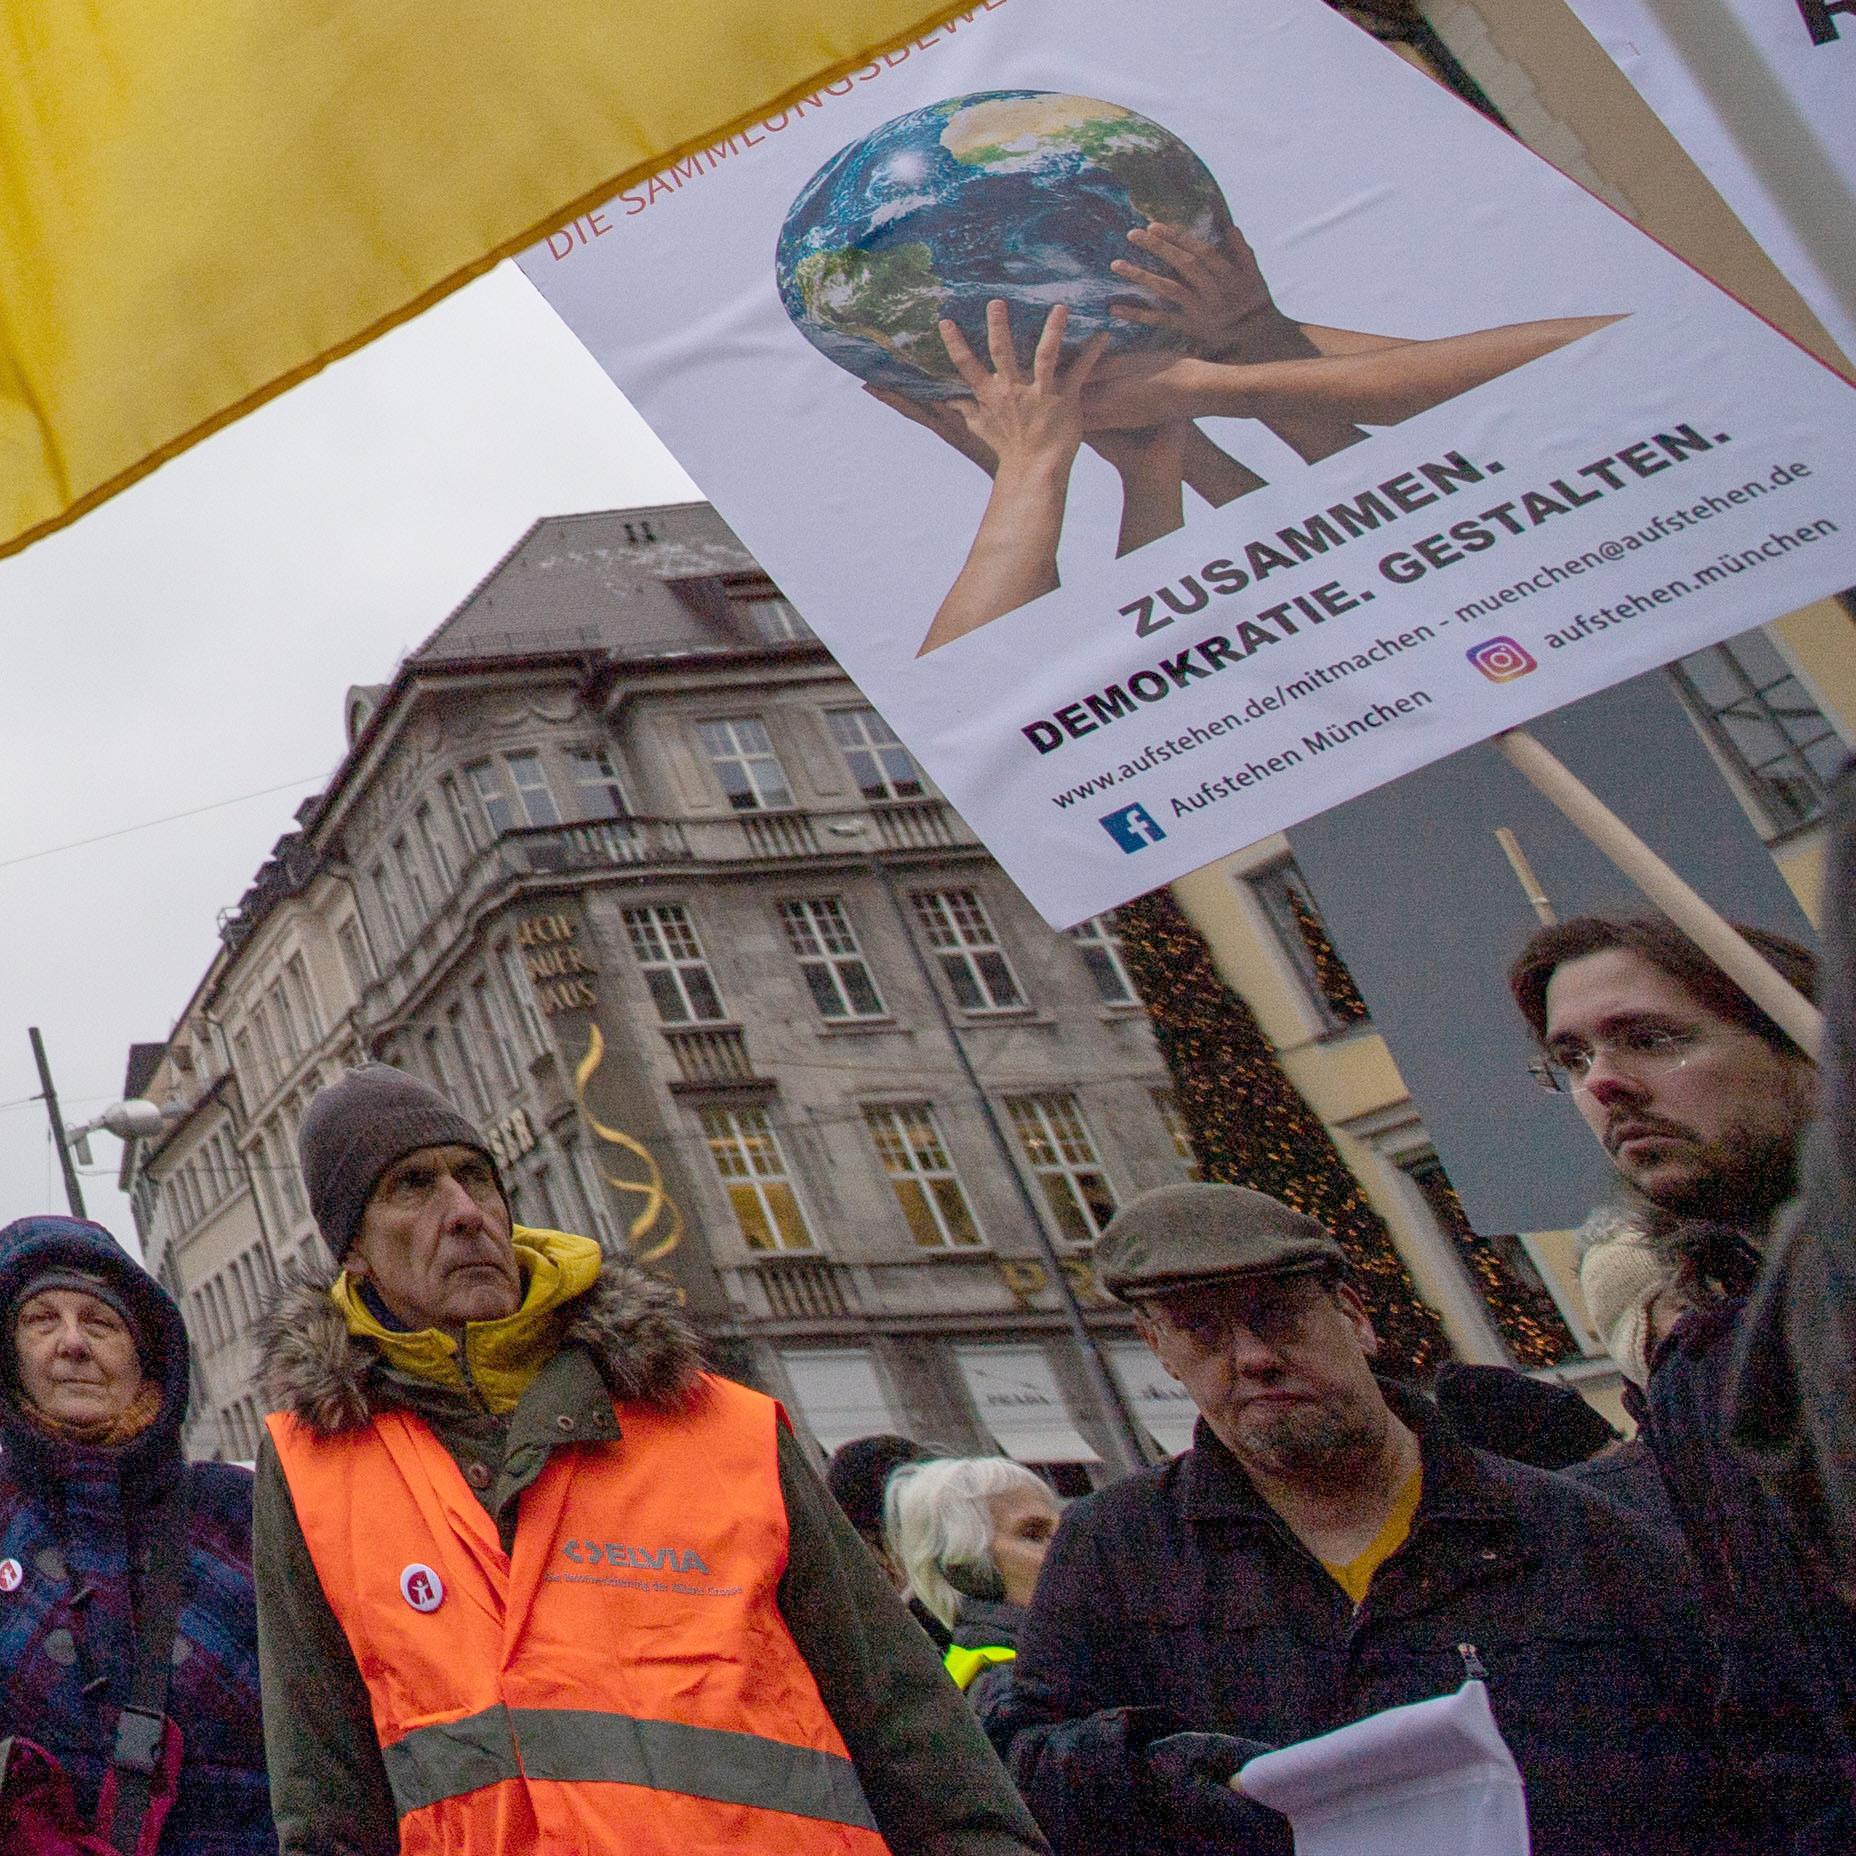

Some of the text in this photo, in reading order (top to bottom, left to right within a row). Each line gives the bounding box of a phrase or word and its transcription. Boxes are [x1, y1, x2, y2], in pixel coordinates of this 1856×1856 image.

[544, 210, 613, 262] DIE
[1021, 423, 1732, 754] DEMOKRATIE. GESTALTEN.
[1052, 624, 1435, 810] www.aufstehen.de/mitmachen
[1457, 457, 1813, 624] muenchen@aufstehen.de
[1118, 449, 1505, 639] ZUSAMMEN.
[1170, 746, 1303, 818] Aufstehen
[1302, 688, 1433, 756] München
[1544, 515, 1838, 650] aufstehen.münchen
[605, 1542, 710, 1576] ELVIA
